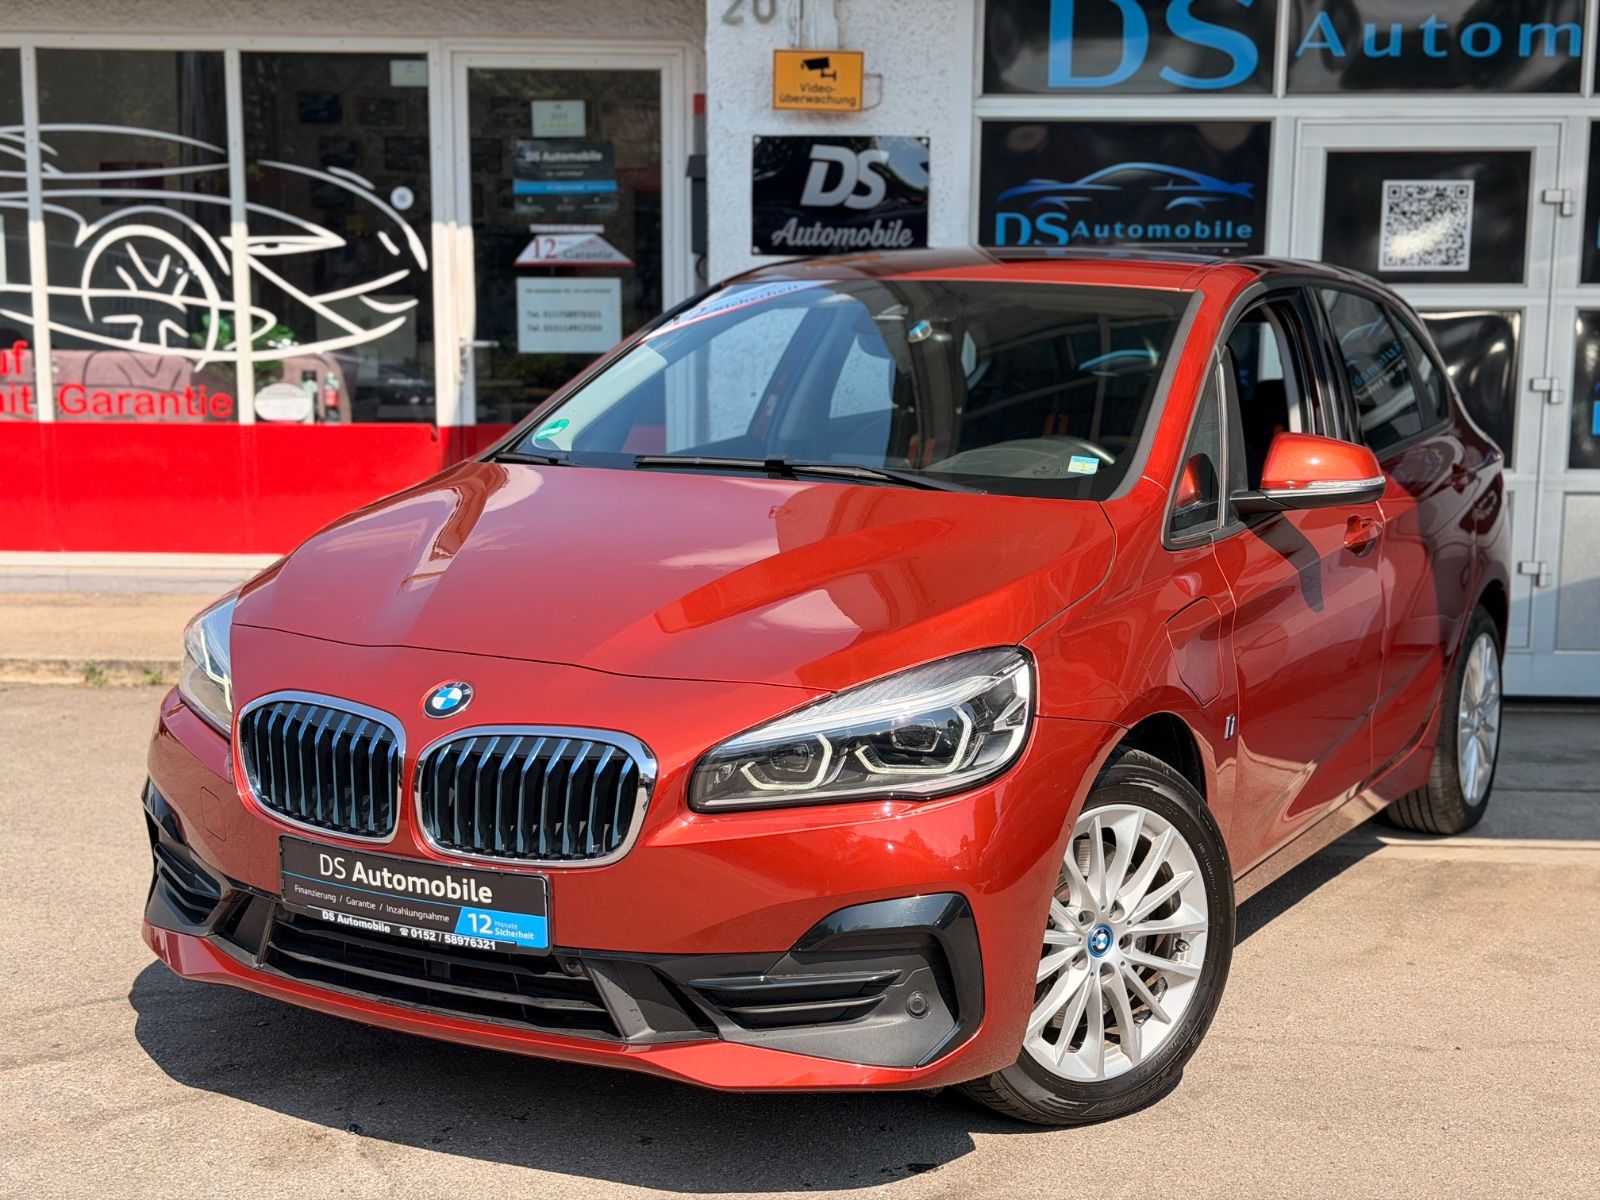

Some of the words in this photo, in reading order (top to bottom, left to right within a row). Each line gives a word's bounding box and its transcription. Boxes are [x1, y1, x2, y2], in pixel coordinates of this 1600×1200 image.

[722, 0, 777, 25] 20
[1047, 0, 1258, 90] DS
[1295, 13, 1582, 58] Autom
[779, 94, 856, 107] überwachung
[800, 83, 835, 93] Video-
[800, 144, 887, 209] DS
[771, 217, 914, 247] Automobile
[995, 212, 1069, 245] DS
[1071, 220, 1253, 239] Automobile
[532, 237, 557, 259] 12
[0, 382, 34, 415] it
[58, 384, 233, 416] Garantie
[319, 853, 347, 879] DS
[352, 861, 493, 904] Automobile
[294, 884, 337, 903] Finanzierung
[346, 896, 376, 910] Garantie
[386, 904, 450, 923] Inzahlungnahme
[322, 910, 335, 921] DS
[337, 914, 391, 933] Automobile
[410, 929, 437, 942] 0152
[444, 934, 496, 950] 58976321
[467, 913, 493, 935] 12
[495, 920, 518, 929] Monate
[495, 927, 535, 940] Sicherheit
